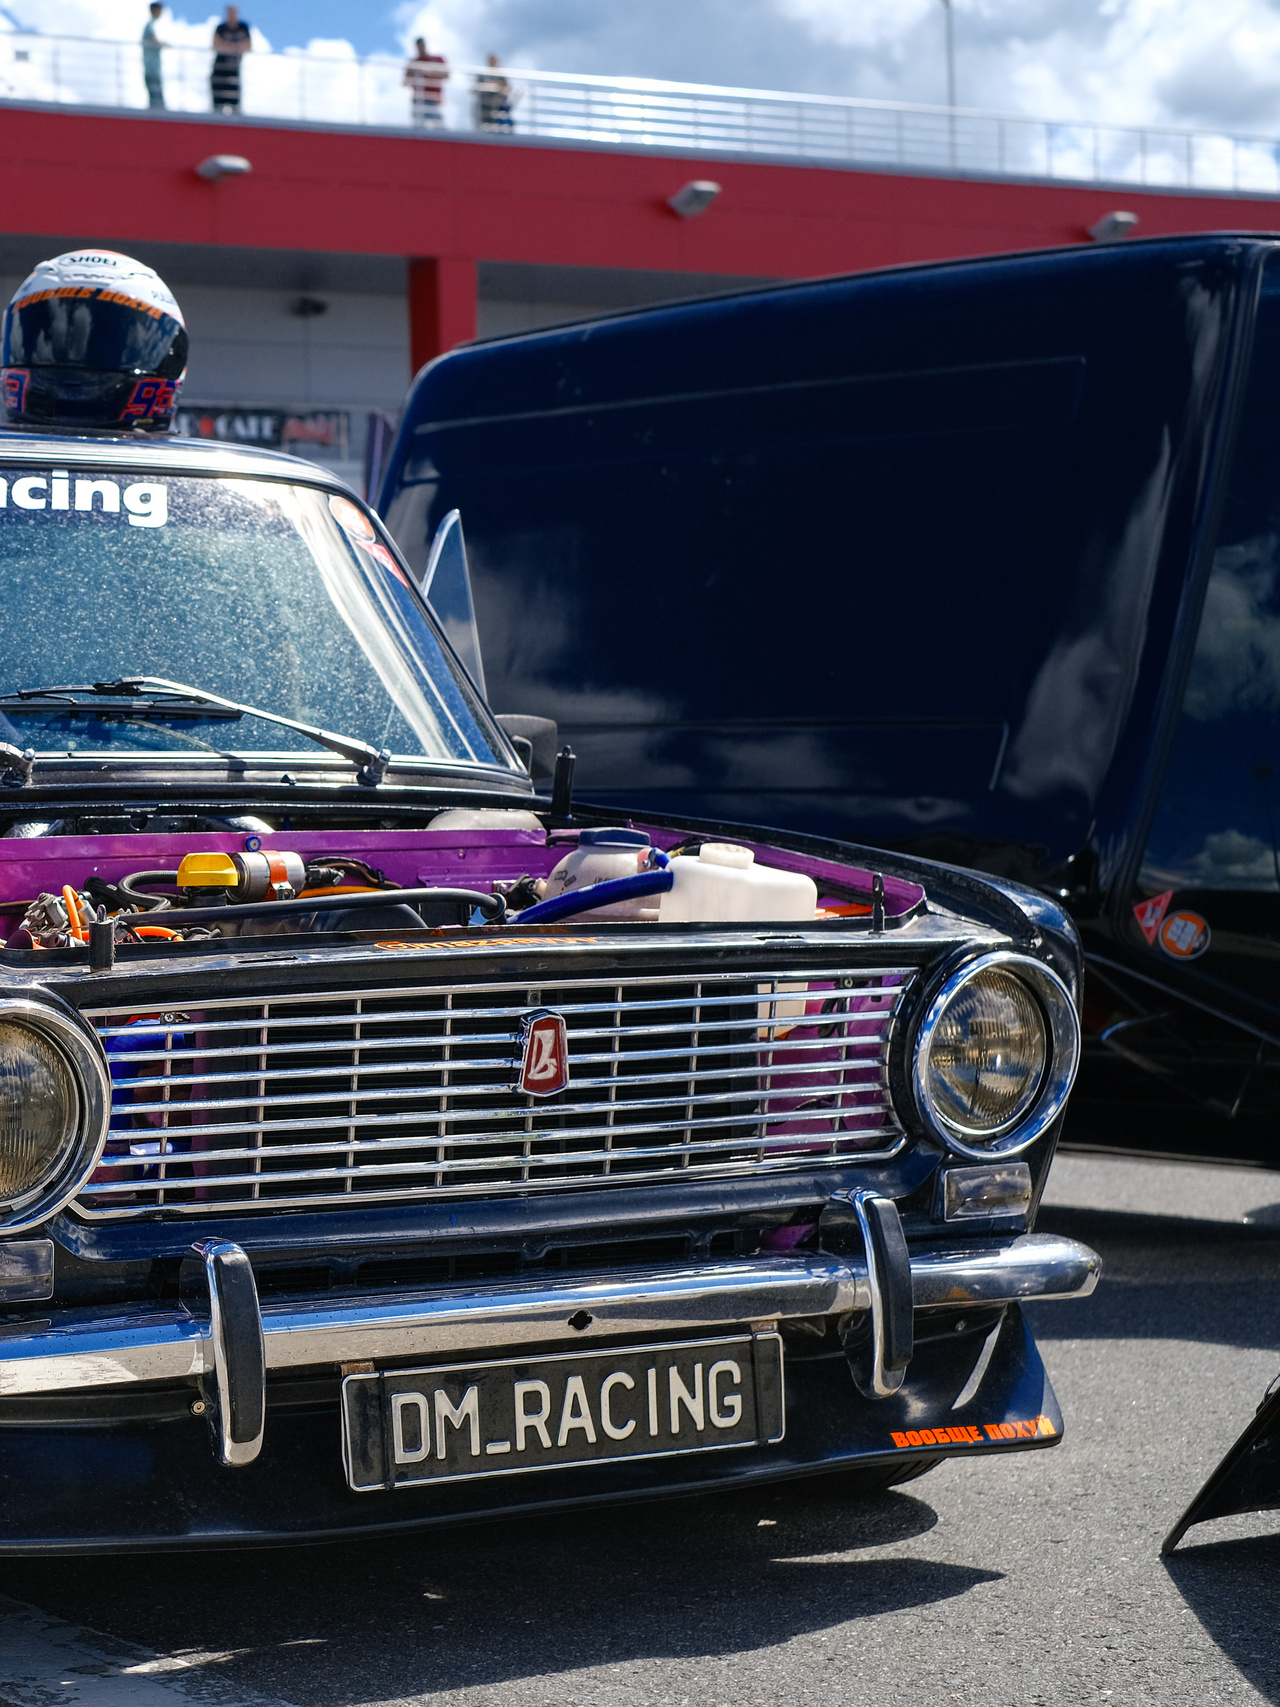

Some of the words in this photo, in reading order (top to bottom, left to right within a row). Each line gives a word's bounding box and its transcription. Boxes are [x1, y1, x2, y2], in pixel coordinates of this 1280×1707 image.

[69, 255, 117, 267] SHOEI
[391, 1360, 743, 1465] DM_RACING
[890, 1425, 984, 1448] ВООБЩЕ
[983, 1415, 1057, 1440] ПОХУЙ
